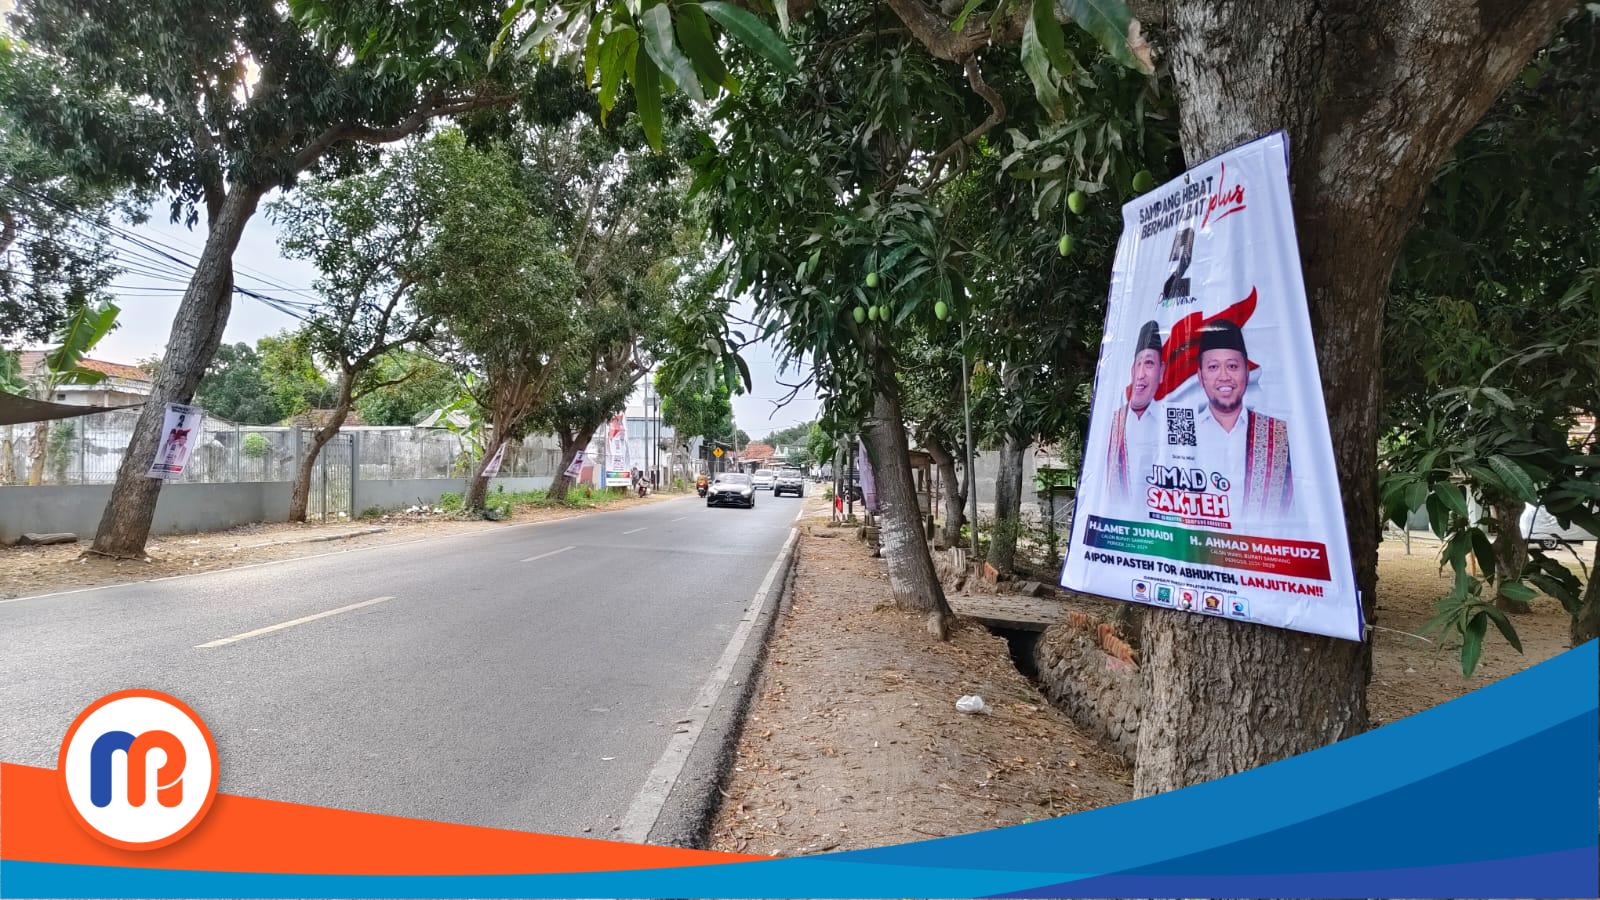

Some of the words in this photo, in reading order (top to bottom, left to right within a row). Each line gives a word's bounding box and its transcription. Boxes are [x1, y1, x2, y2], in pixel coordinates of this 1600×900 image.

[1140, 191, 1181, 224] SAMPANG
[1182, 176, 1214, 205] HEBAT
[1201, 161, 1245, 229] plus
[1163, 227, 1195, 299] 2
[1146, 464, 1207, 492] JIMAD
[1147, 487, 1230, 518] SAKTEH
[1132, 527, 1174, 542] JUNAIDI
[1189, 535, 1202, 546] H.
[1205, 537, 1250, 551] AHMAD
[1252, 543, 1321, 560] MAHFUDZ
[1116, 556, 1155, 571] PASTEH
[1157, 561, 1177, 576] TOR
[1180, 567, 1239, 586] ABHUKTEH,
[1240, 575, 1324, 597] LANJUTKAN!!
